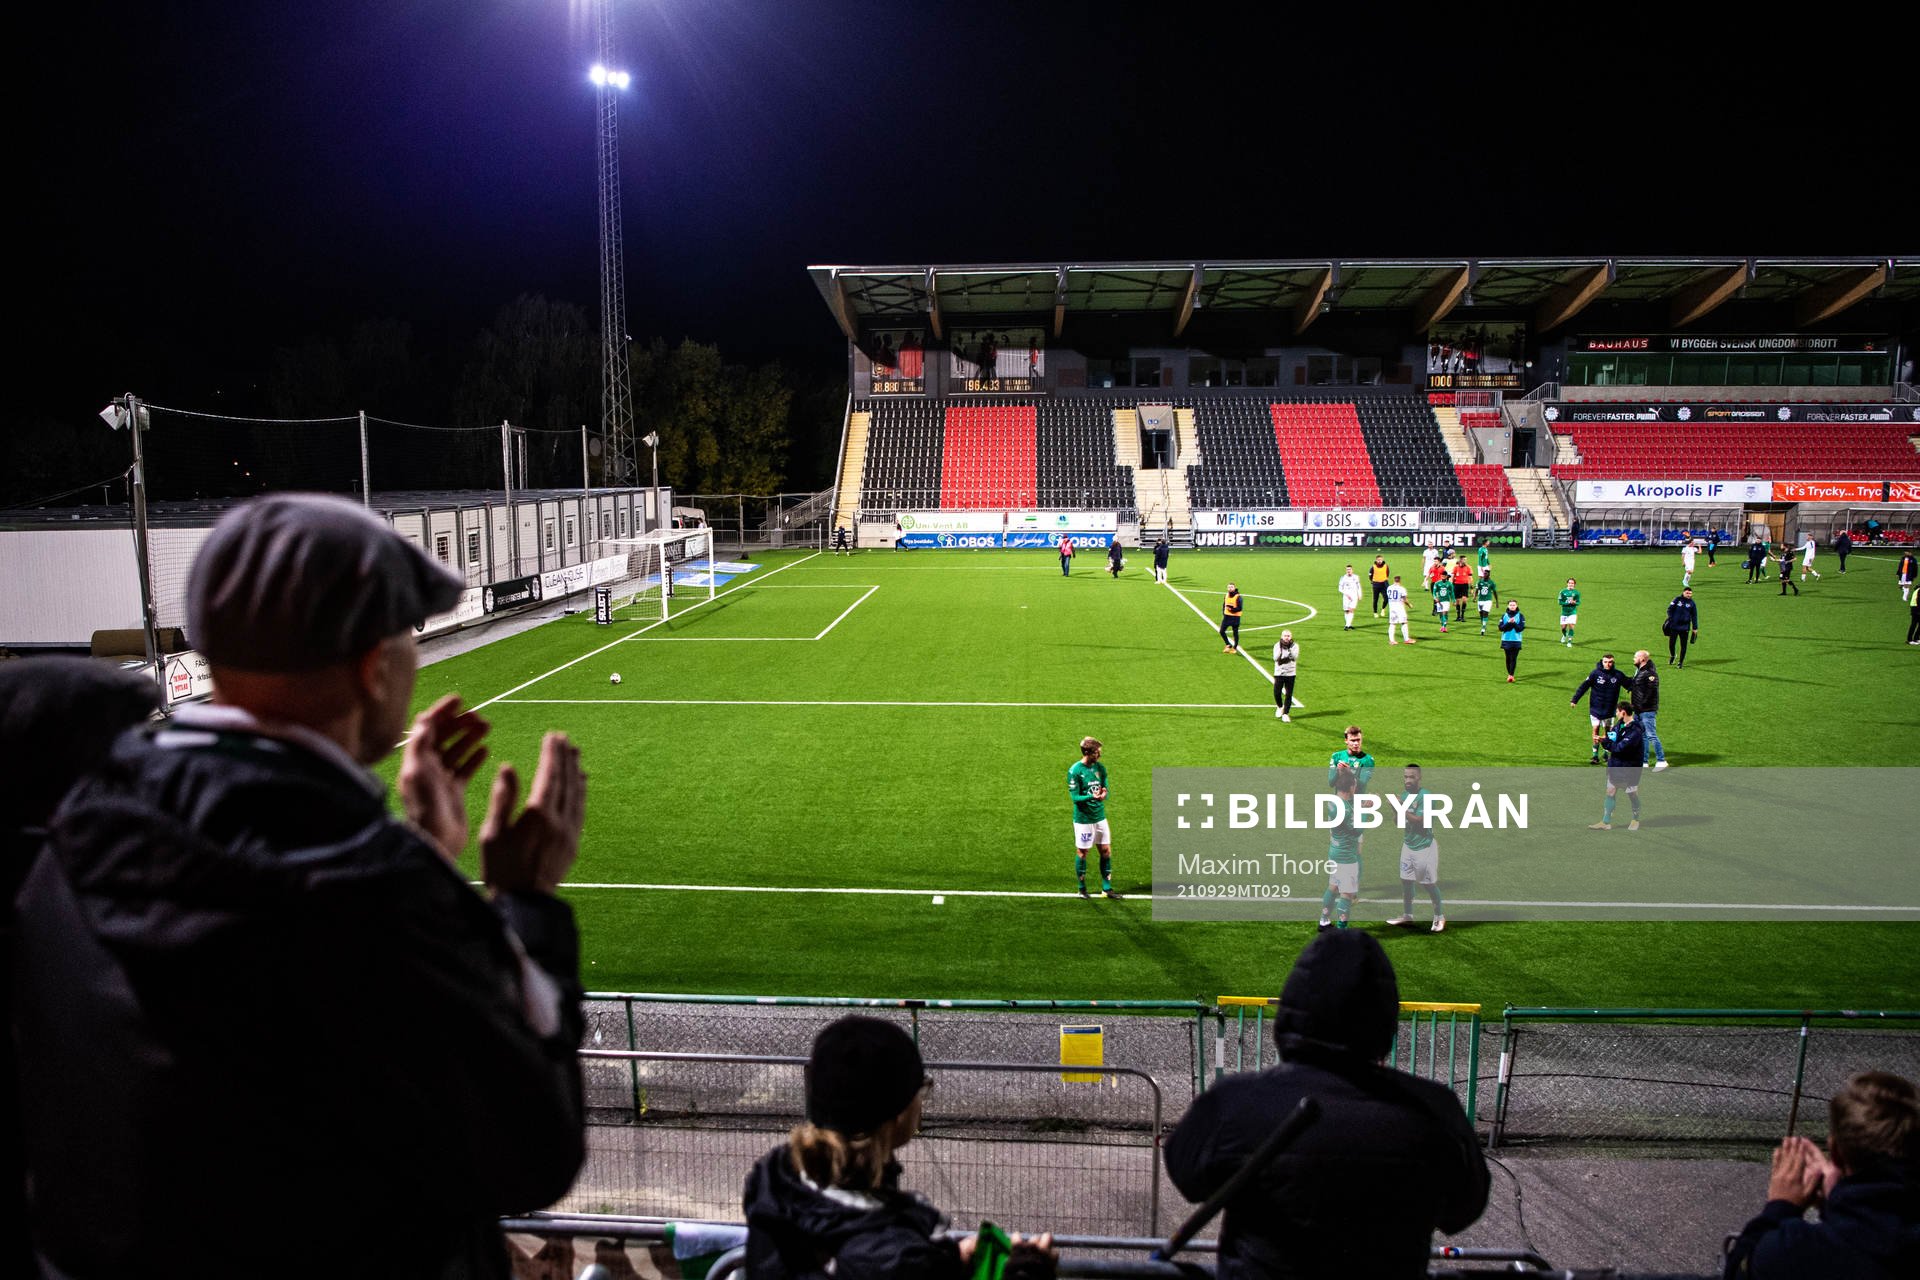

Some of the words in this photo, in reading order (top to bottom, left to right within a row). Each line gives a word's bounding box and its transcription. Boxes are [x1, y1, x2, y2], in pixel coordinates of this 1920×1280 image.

[1590, 340, 1648, 348] BAUHAUS
[1670, 338, 1679, 348] VI
[1682, 338, 1718, 348] BYGGER
[1430, 375, 1453, 387] 1000
[1625, 484, 1702, 498] Akropolis
[1708, 484, 1724, 496] IF
[1217, 513, 1274, 528] MFlytt.se
[1326, 513, 1351, 527] BSIS
[1381, 513, 1406, 527] BSIS
[959, 537, 994, 547] OBOS
[1072, 537, 1106, 547] OBOS
[1196, 532, 1258, 546] UNIBET
[1302, 532, 1366, 546] UNIBET
[1413, 533, 1476, 546] UNIBET
[1387, 589, 1398, 600] 20
